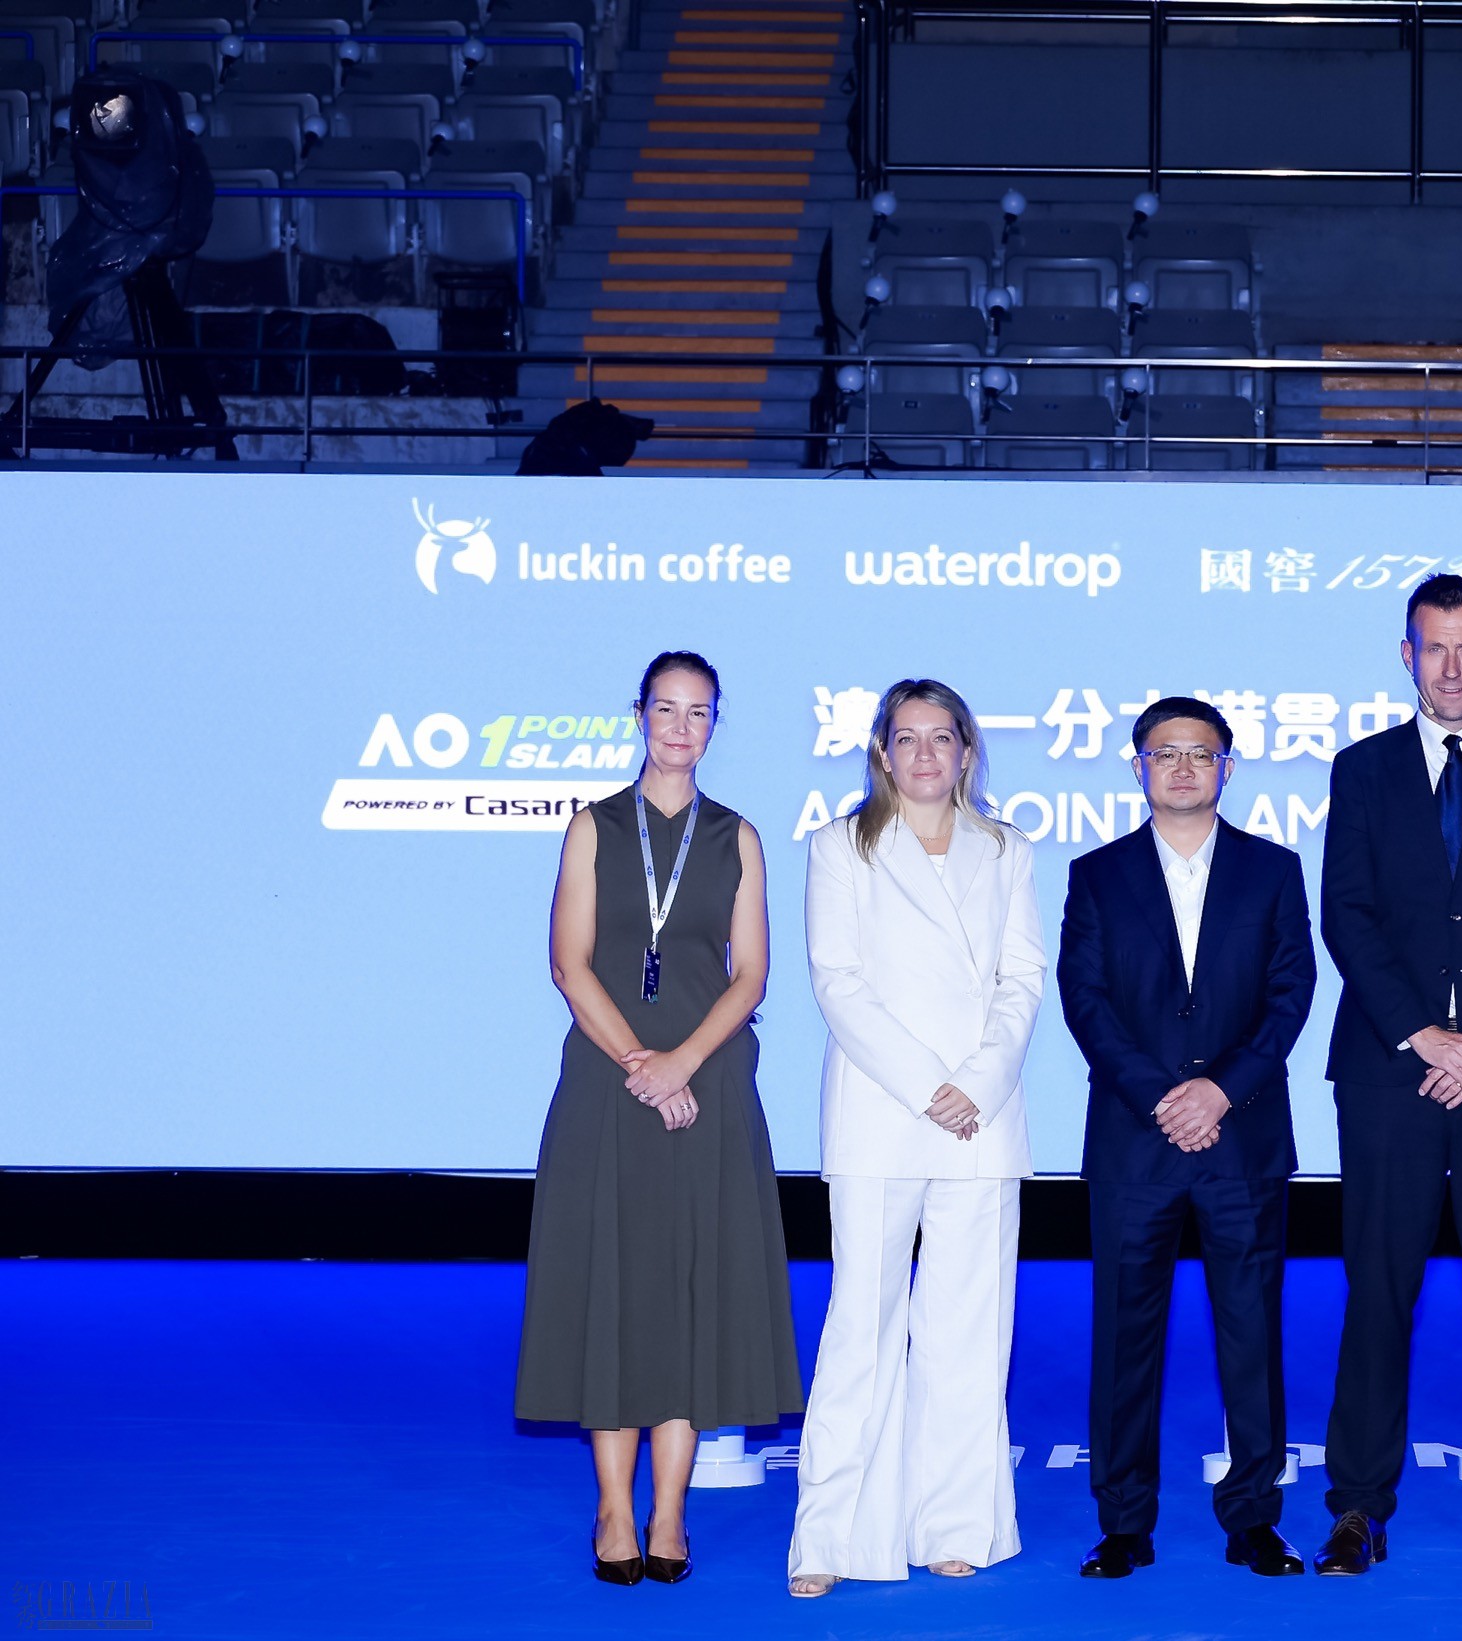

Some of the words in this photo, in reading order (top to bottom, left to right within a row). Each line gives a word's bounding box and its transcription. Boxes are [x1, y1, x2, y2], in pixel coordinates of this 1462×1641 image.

[518, 542, 645, 582] luckin
[658, 543, 791, 583] coffee
[845, 540, 1122, 597] waterdrop
[1200, 547, 1318, 594] 國窖
[358, 712, 470, 769] AO
[480, 715, 517, 768] 1
[516, 715, 635, 740] POINT
[506, 743, 636, 769] SLAM
[343, 800, 428, 810] POWERED
[433, 801, 456, 810] BY
[465, 796, 599, 816] Casart
[986, 790, 1151, 844] OINT
